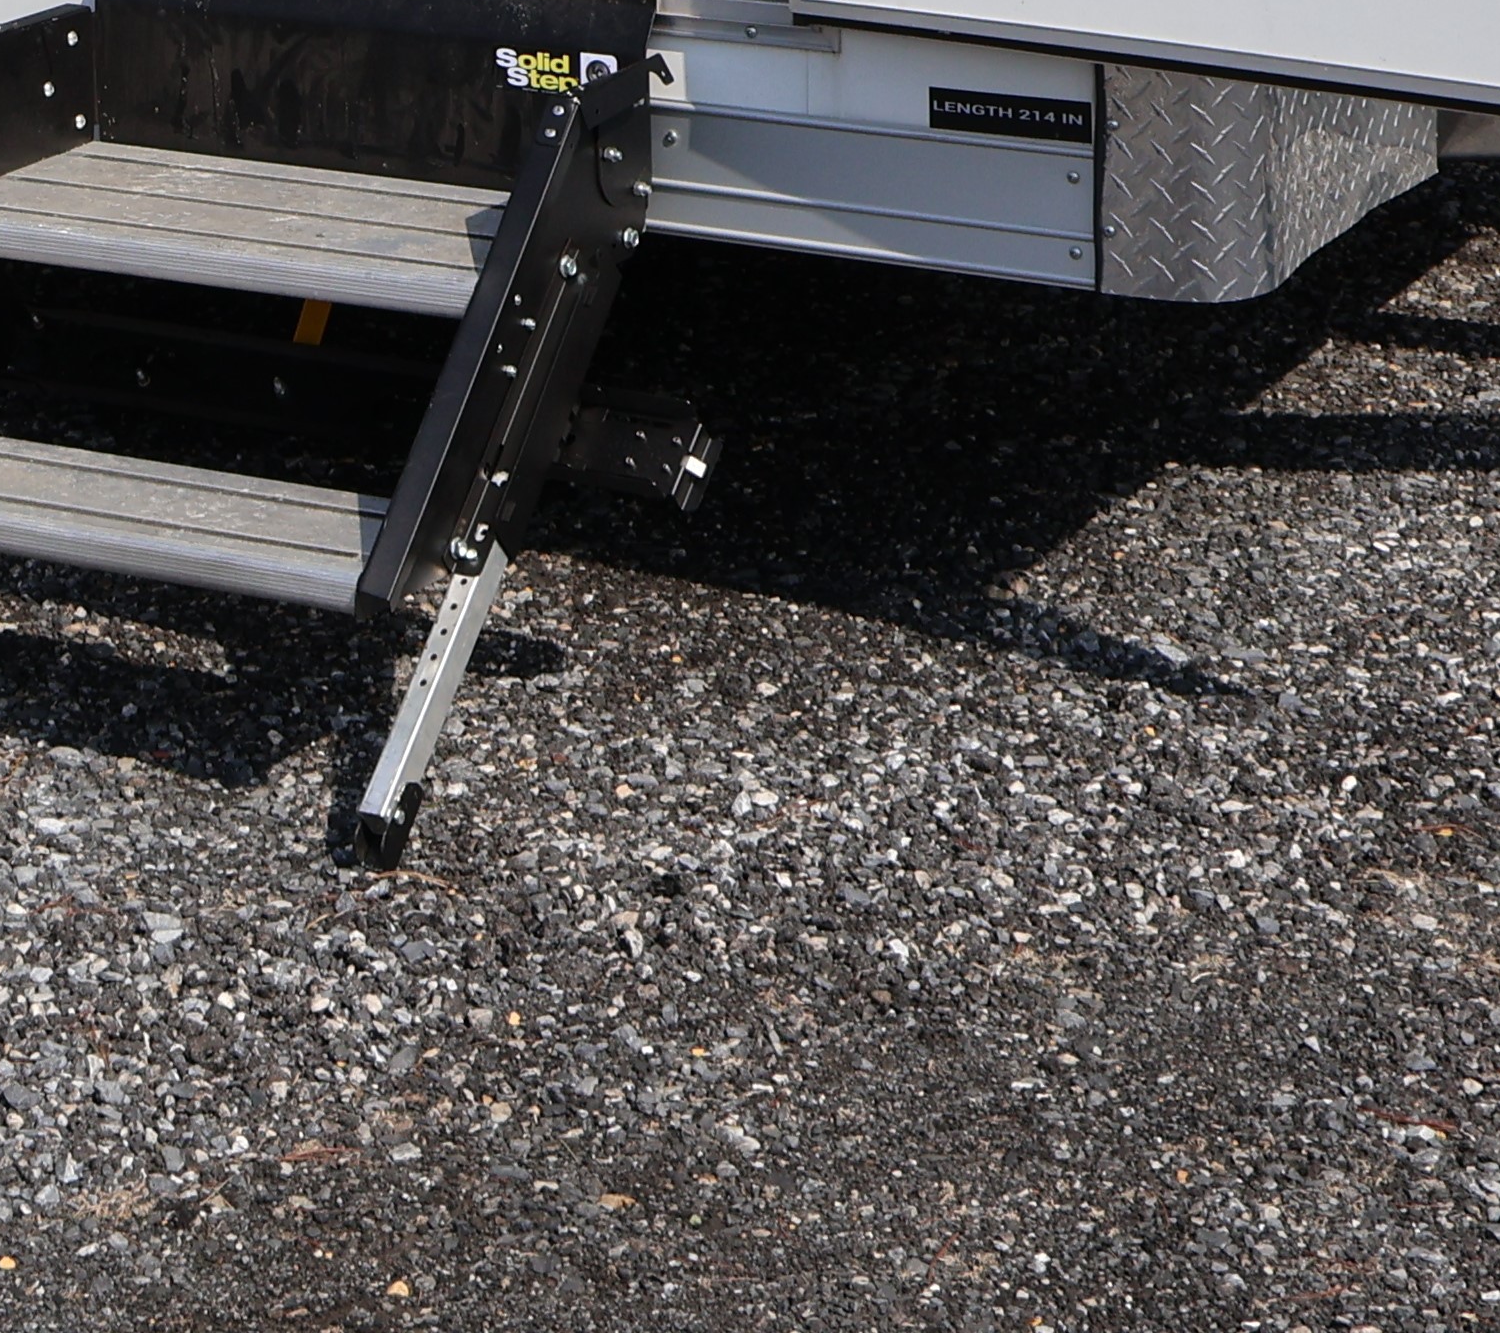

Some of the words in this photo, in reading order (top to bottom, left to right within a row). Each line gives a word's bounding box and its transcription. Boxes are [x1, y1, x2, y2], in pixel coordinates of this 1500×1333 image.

[496, 48, 570, 74] Solid
[932, 99, 1013, 119] LENGTH
[1018, 109, 1056, 123] 214
[1061, 113, 1083, 126] IN
